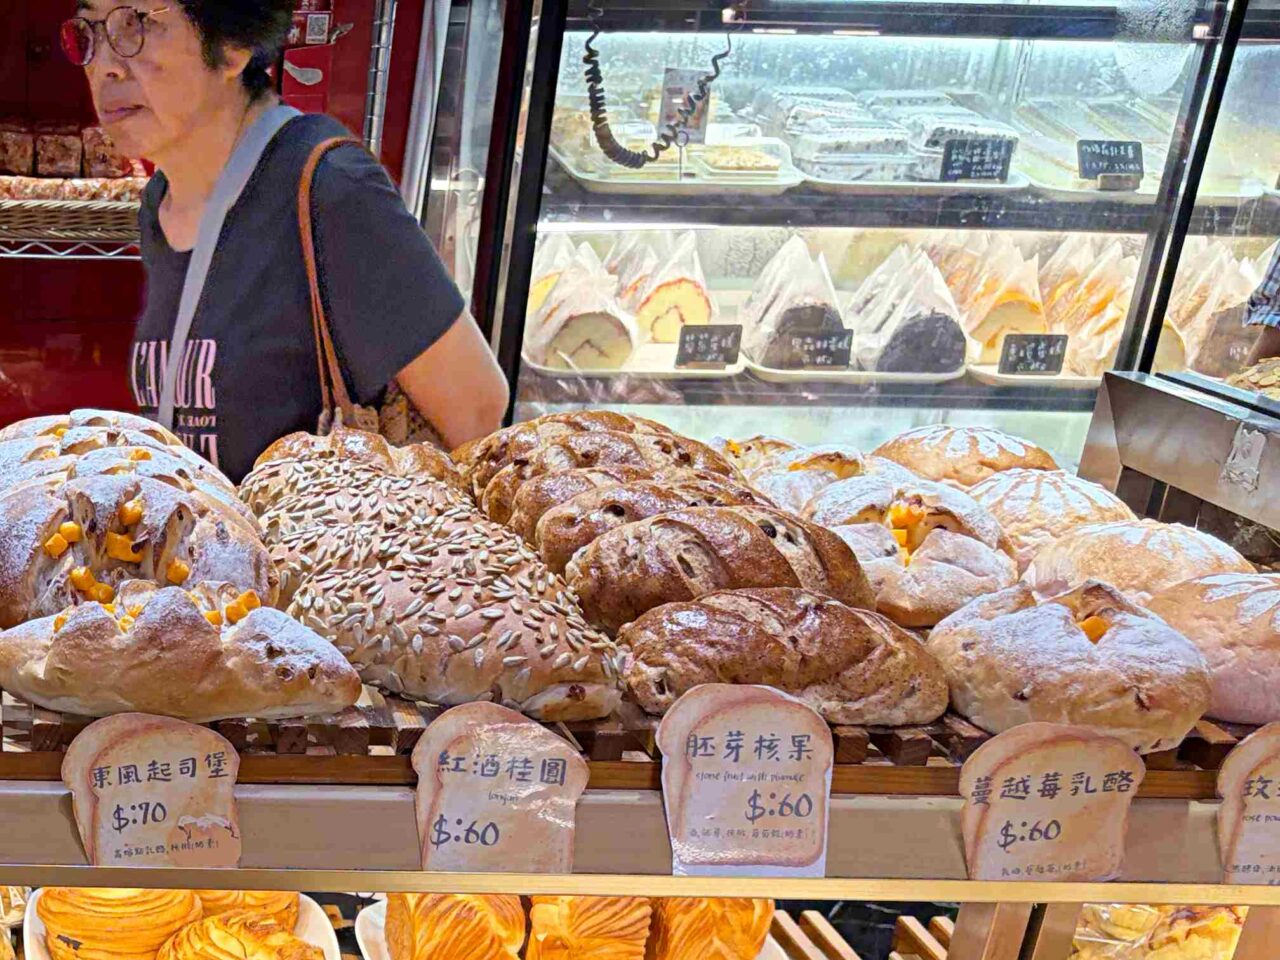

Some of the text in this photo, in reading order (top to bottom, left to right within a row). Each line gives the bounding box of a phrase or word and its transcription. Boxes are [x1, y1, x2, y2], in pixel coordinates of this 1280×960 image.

[686, 730, 815, 763] 胚芽核果
[91, 751, 230, 789] 東風起司堡
[436, 751, 568, 787] 紅酒桂圓
[970, 769, 1135, 809] 蔓越莓乳酪
